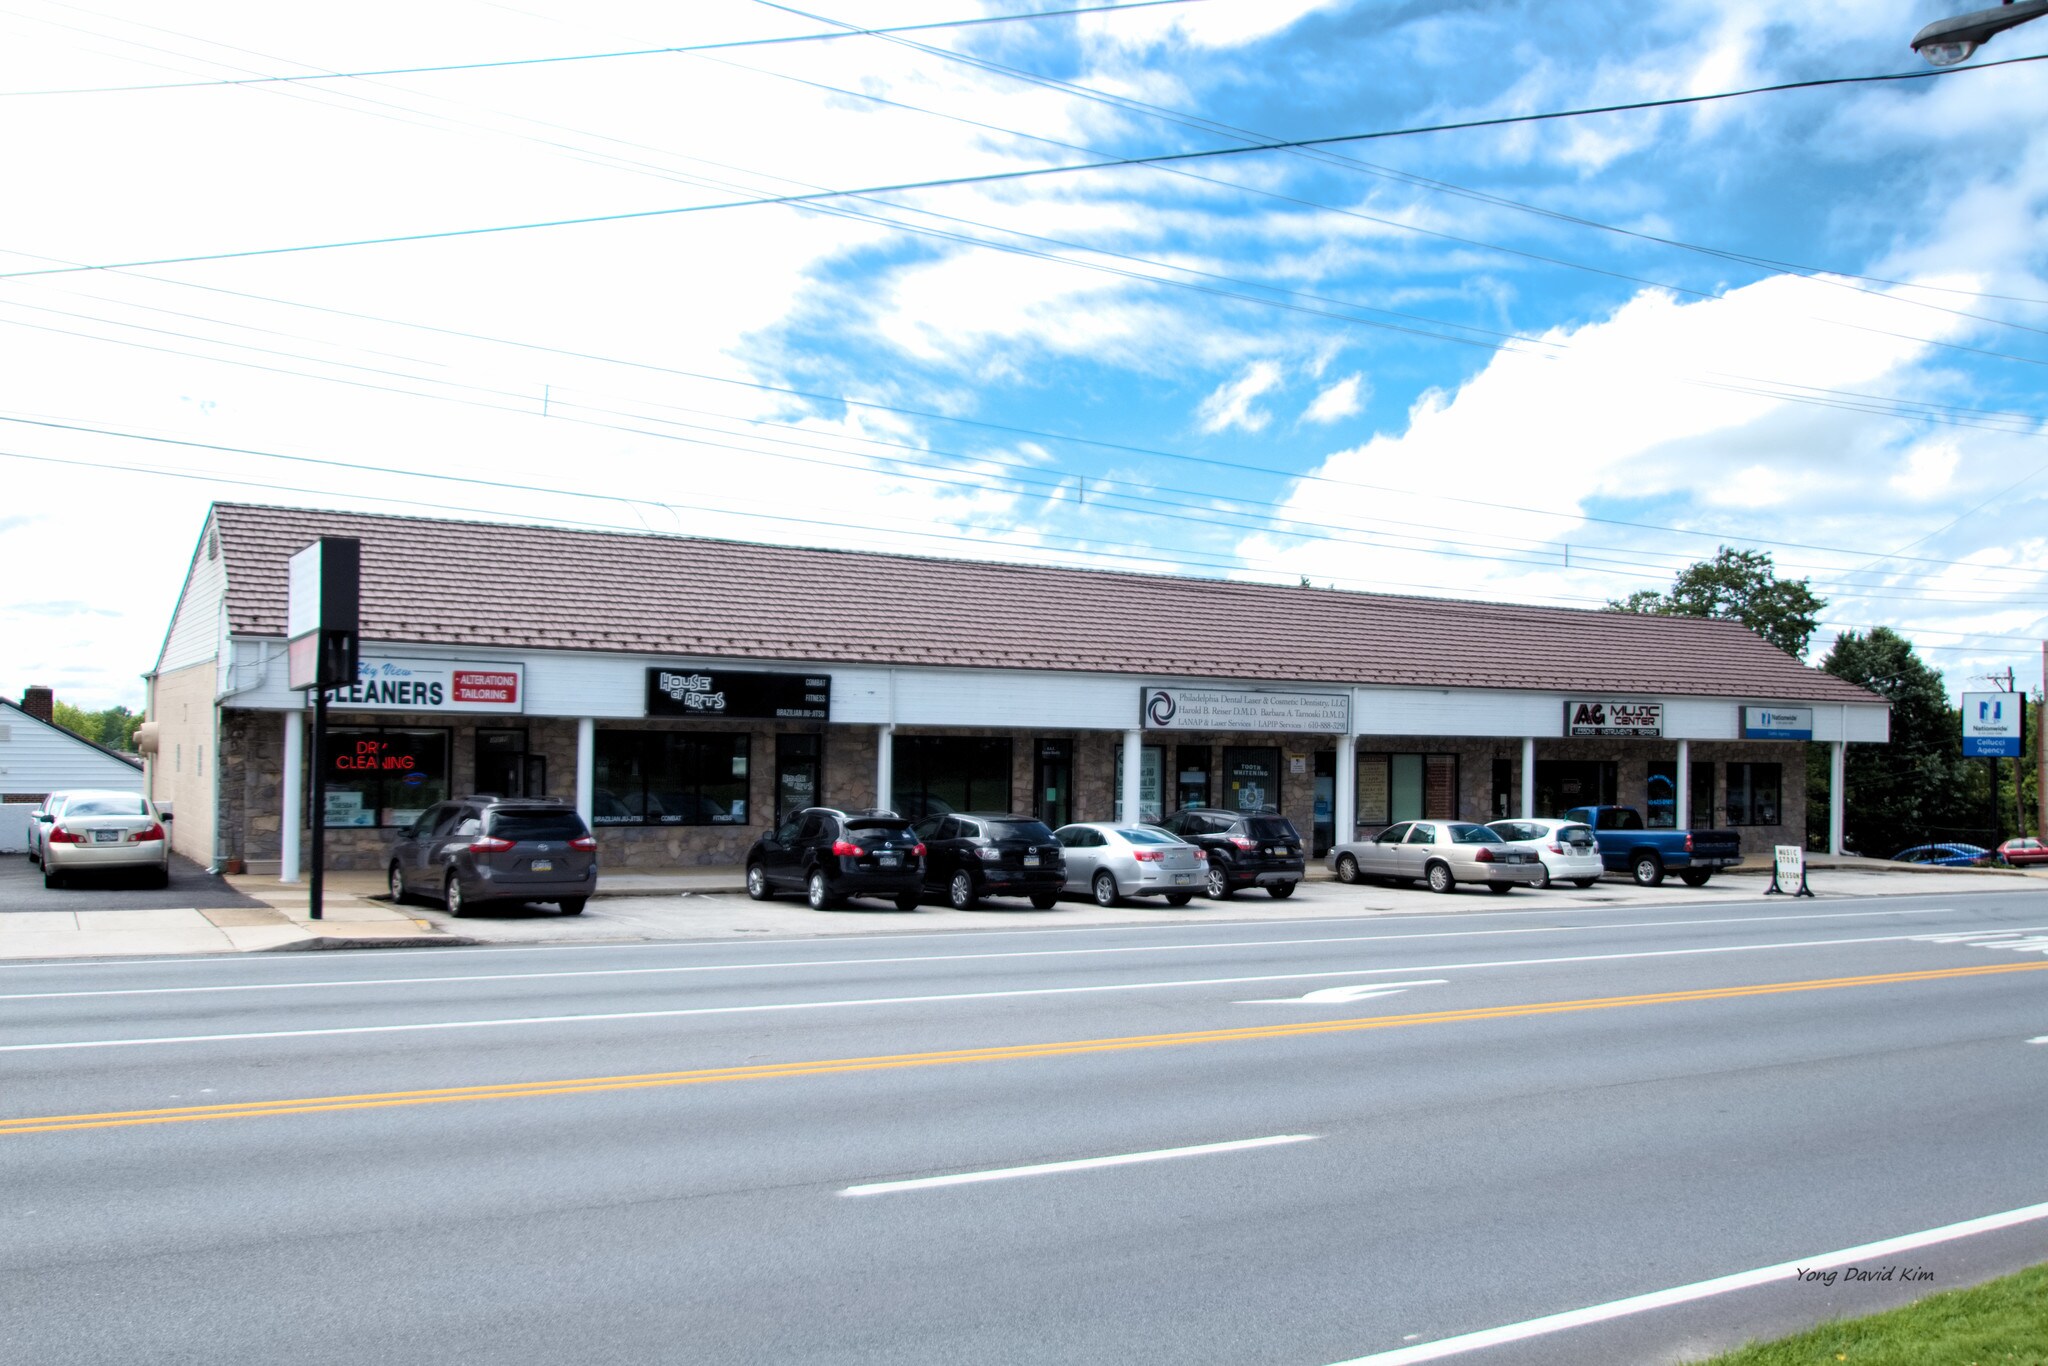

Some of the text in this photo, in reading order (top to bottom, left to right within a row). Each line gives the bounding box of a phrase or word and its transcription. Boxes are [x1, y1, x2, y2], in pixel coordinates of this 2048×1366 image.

[382, 662, 413, 676] View
[460, 675, 515, 686] ALTERATIONS
[660, 672, 712, 691] HOUSE
[326, 680, 443, 705] LEANERS
[460, 688, 507, 699] TAILORING
[671, 689, 683, 699] OF
[685, 692, 725, 709] ARTS
[1179, 693, 1218, 704] Philadelphia
[1221, 695, 1242, 704] Dental
[1244, 696, 1262, 704] Laser
[1270, 697, 1299, 705] Cosmetic
[1331, 699, 1346, 707] LLC
[776, 709, 825, 717] BRAZILIAN JIU-JITSU
[1179, 706, 1201, 714] Harold
[1212, 707, 1231, 715] Reiser
[1261, 708, 1285, 716] Barbara
[1610, 705, 1660, 716] MUSIC
[1615, 717, 1655, 725] CENTER
[1778, 856, 1798, 864] STORE
